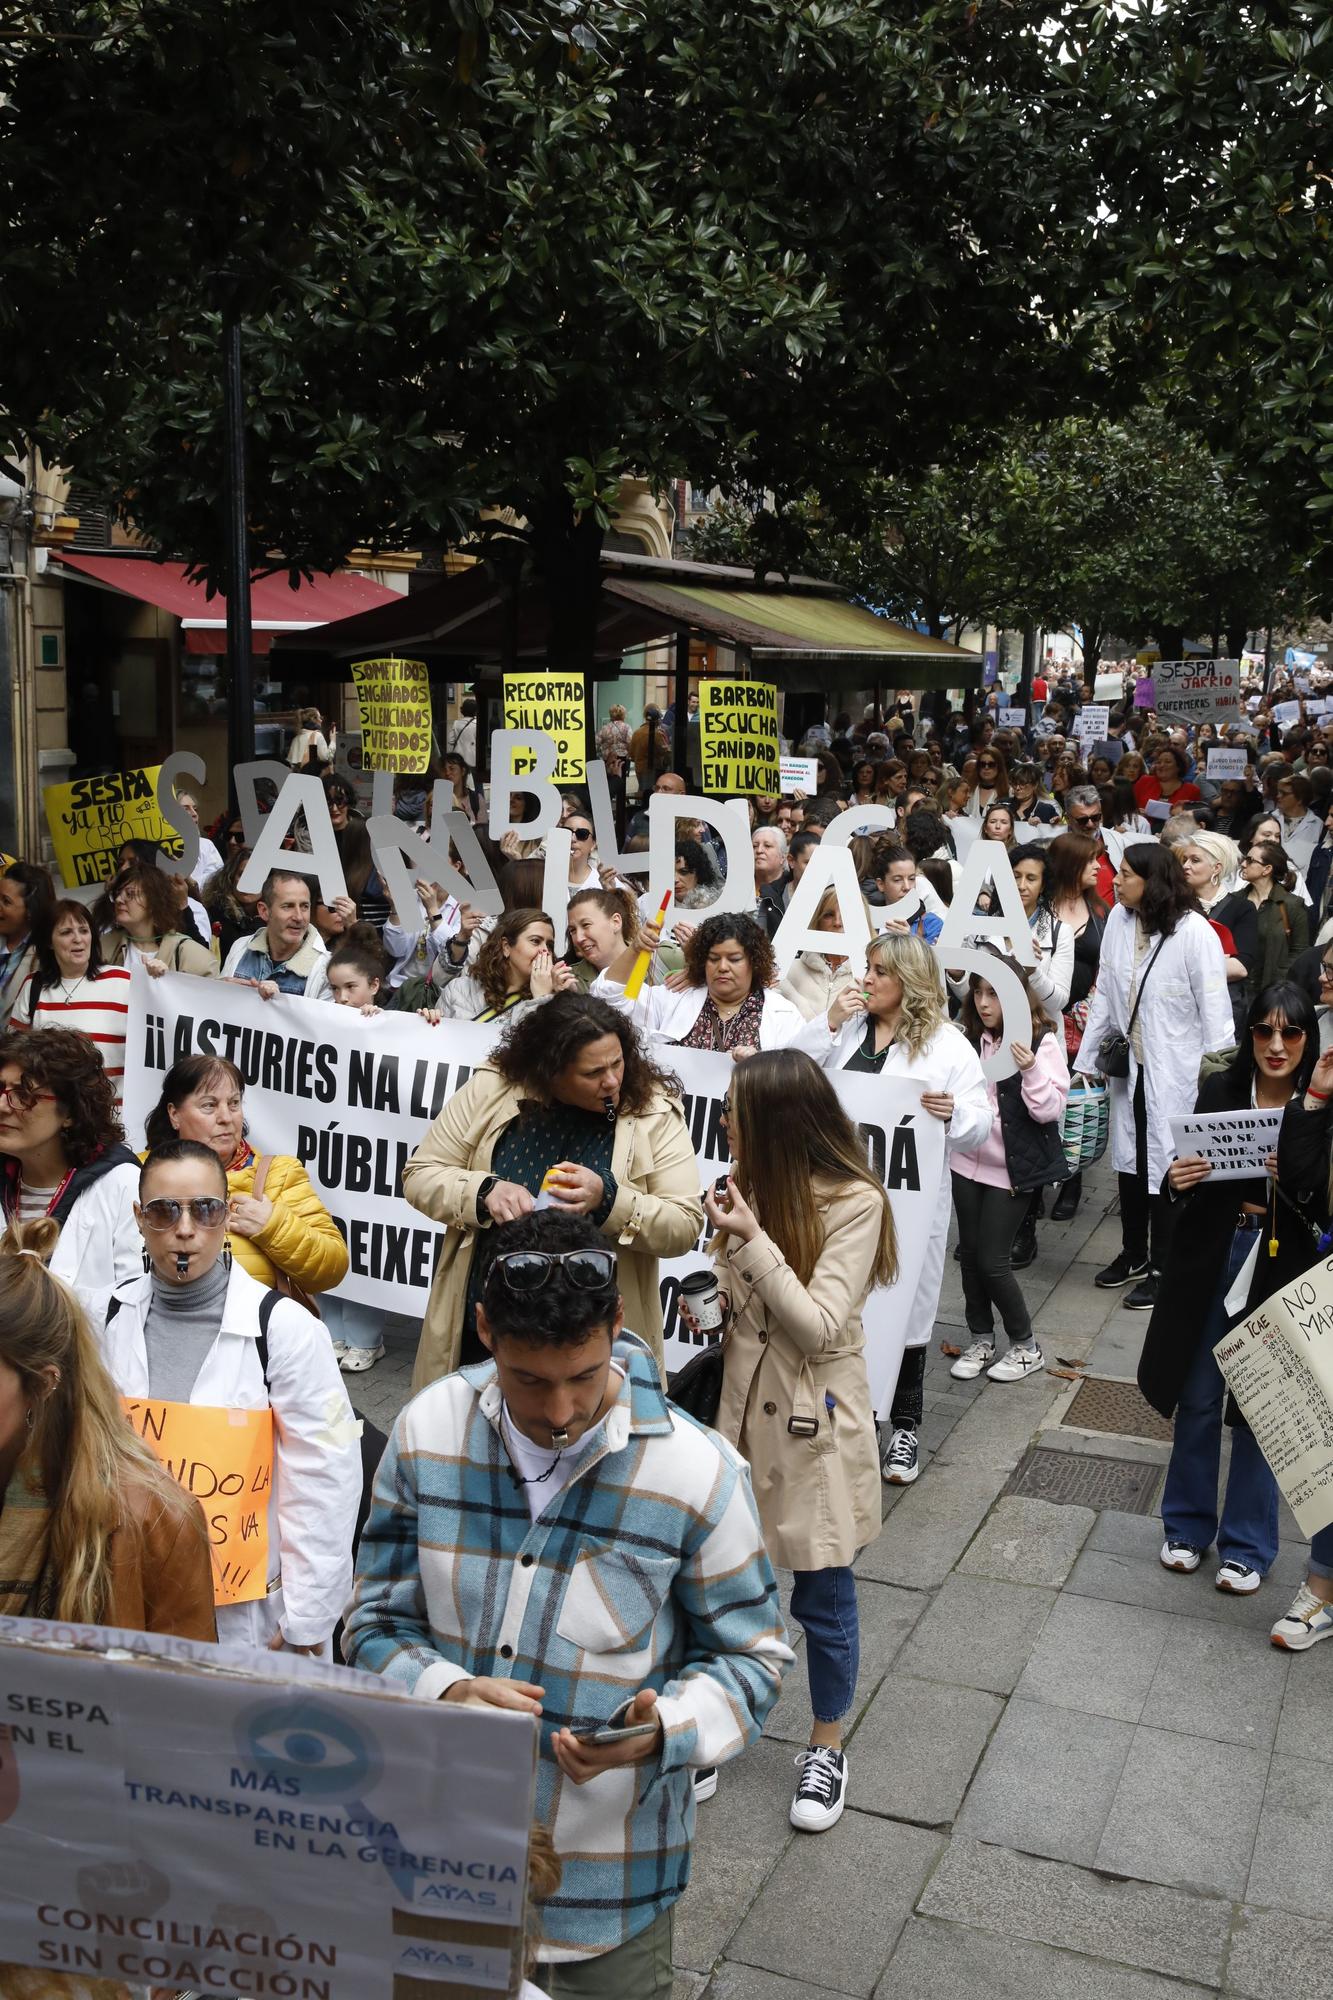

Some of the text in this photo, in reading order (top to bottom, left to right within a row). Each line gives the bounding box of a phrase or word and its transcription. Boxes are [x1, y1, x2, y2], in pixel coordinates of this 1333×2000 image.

[1160, 661, 1215, 679] SESPA
[357, 683, 428, 703] ENGAÑADOS
[505, 682, 584, 702] RECORTAD
[710, 684, 775, 710] BARBÓN
[360, 706, 430, 728] SILENCIADOS
[505, 706, 584, 731] SILLONES
[704, 712, 778, 738] ESCUCHA
[363, 729, 430, 752] PUTEADOS
[704, 738, 776, 763] SANIDAD
[363, 752, 427, 772] AGOTADOS
[514, 758, 584, 777] PENES
[70, 769, 154, 810] SESPA
[703, 764, 781, 793] EN LUCHA
[62, 802, 125, 836] ya no
[85, 820, 135, 850] CREO
[347, 1050, 401, 1114] NA
[1184, 1117, 1279, 1134] LA SANIDAD
[1211, 1133, 1256, 1144] NO SE
[298, 1121, 419, 1198] PÚBLI
[1196, 1144, 1277, 1158] VENDE. SE
[1210, 1158, 1267, 1170] EFIEN
[1282, 1281, 1317, 1319] NO
[1243, 1313, 1271, 1339] TCAE
[240, 1511, 259, 1541] VA
[7, 1693, 110, 1725] SESPA
[47, 1730, 84, 1754] EL
[229, 1766, 301, 1797] MÁS
[124, 1781, 399, 1840] TRANSPARENCIA
[254, 1828, 518, 1885] EN LA GERENCIA
[421, 1883, 497, 1906] ATAS
[36, 1903, 337, 1967] CONCILIACIÓN
[37, 1940, 331, 2000] SIN COACCIÓN
[401, 1946, 475, 1968] ATAS
